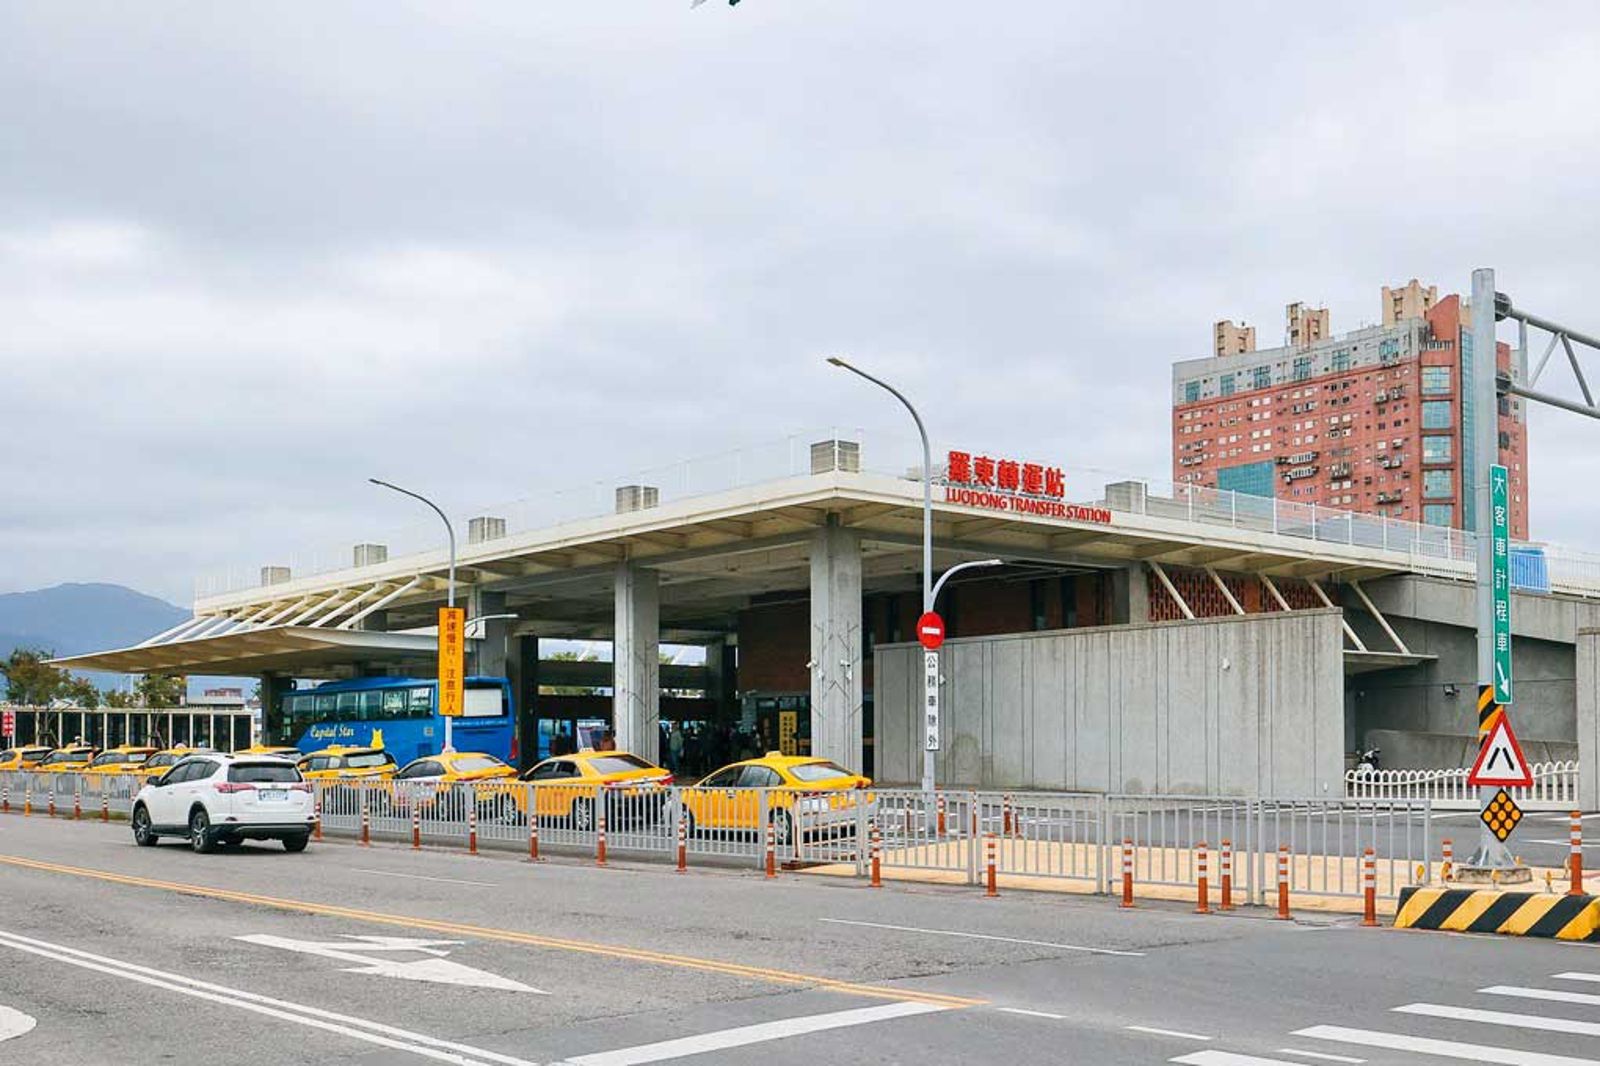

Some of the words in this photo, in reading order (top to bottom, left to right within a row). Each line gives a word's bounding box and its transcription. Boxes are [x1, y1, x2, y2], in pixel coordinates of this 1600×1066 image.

[948, 450, 1065, 498] 羅東轉運站
[946, 487, 1007, 509] LUODONG
[1010, 496, 1066, 518] TRANSFER
[1066, 506, 1112, 523] STATION
[1494, 474, 1507, 651] 大客車計程車
